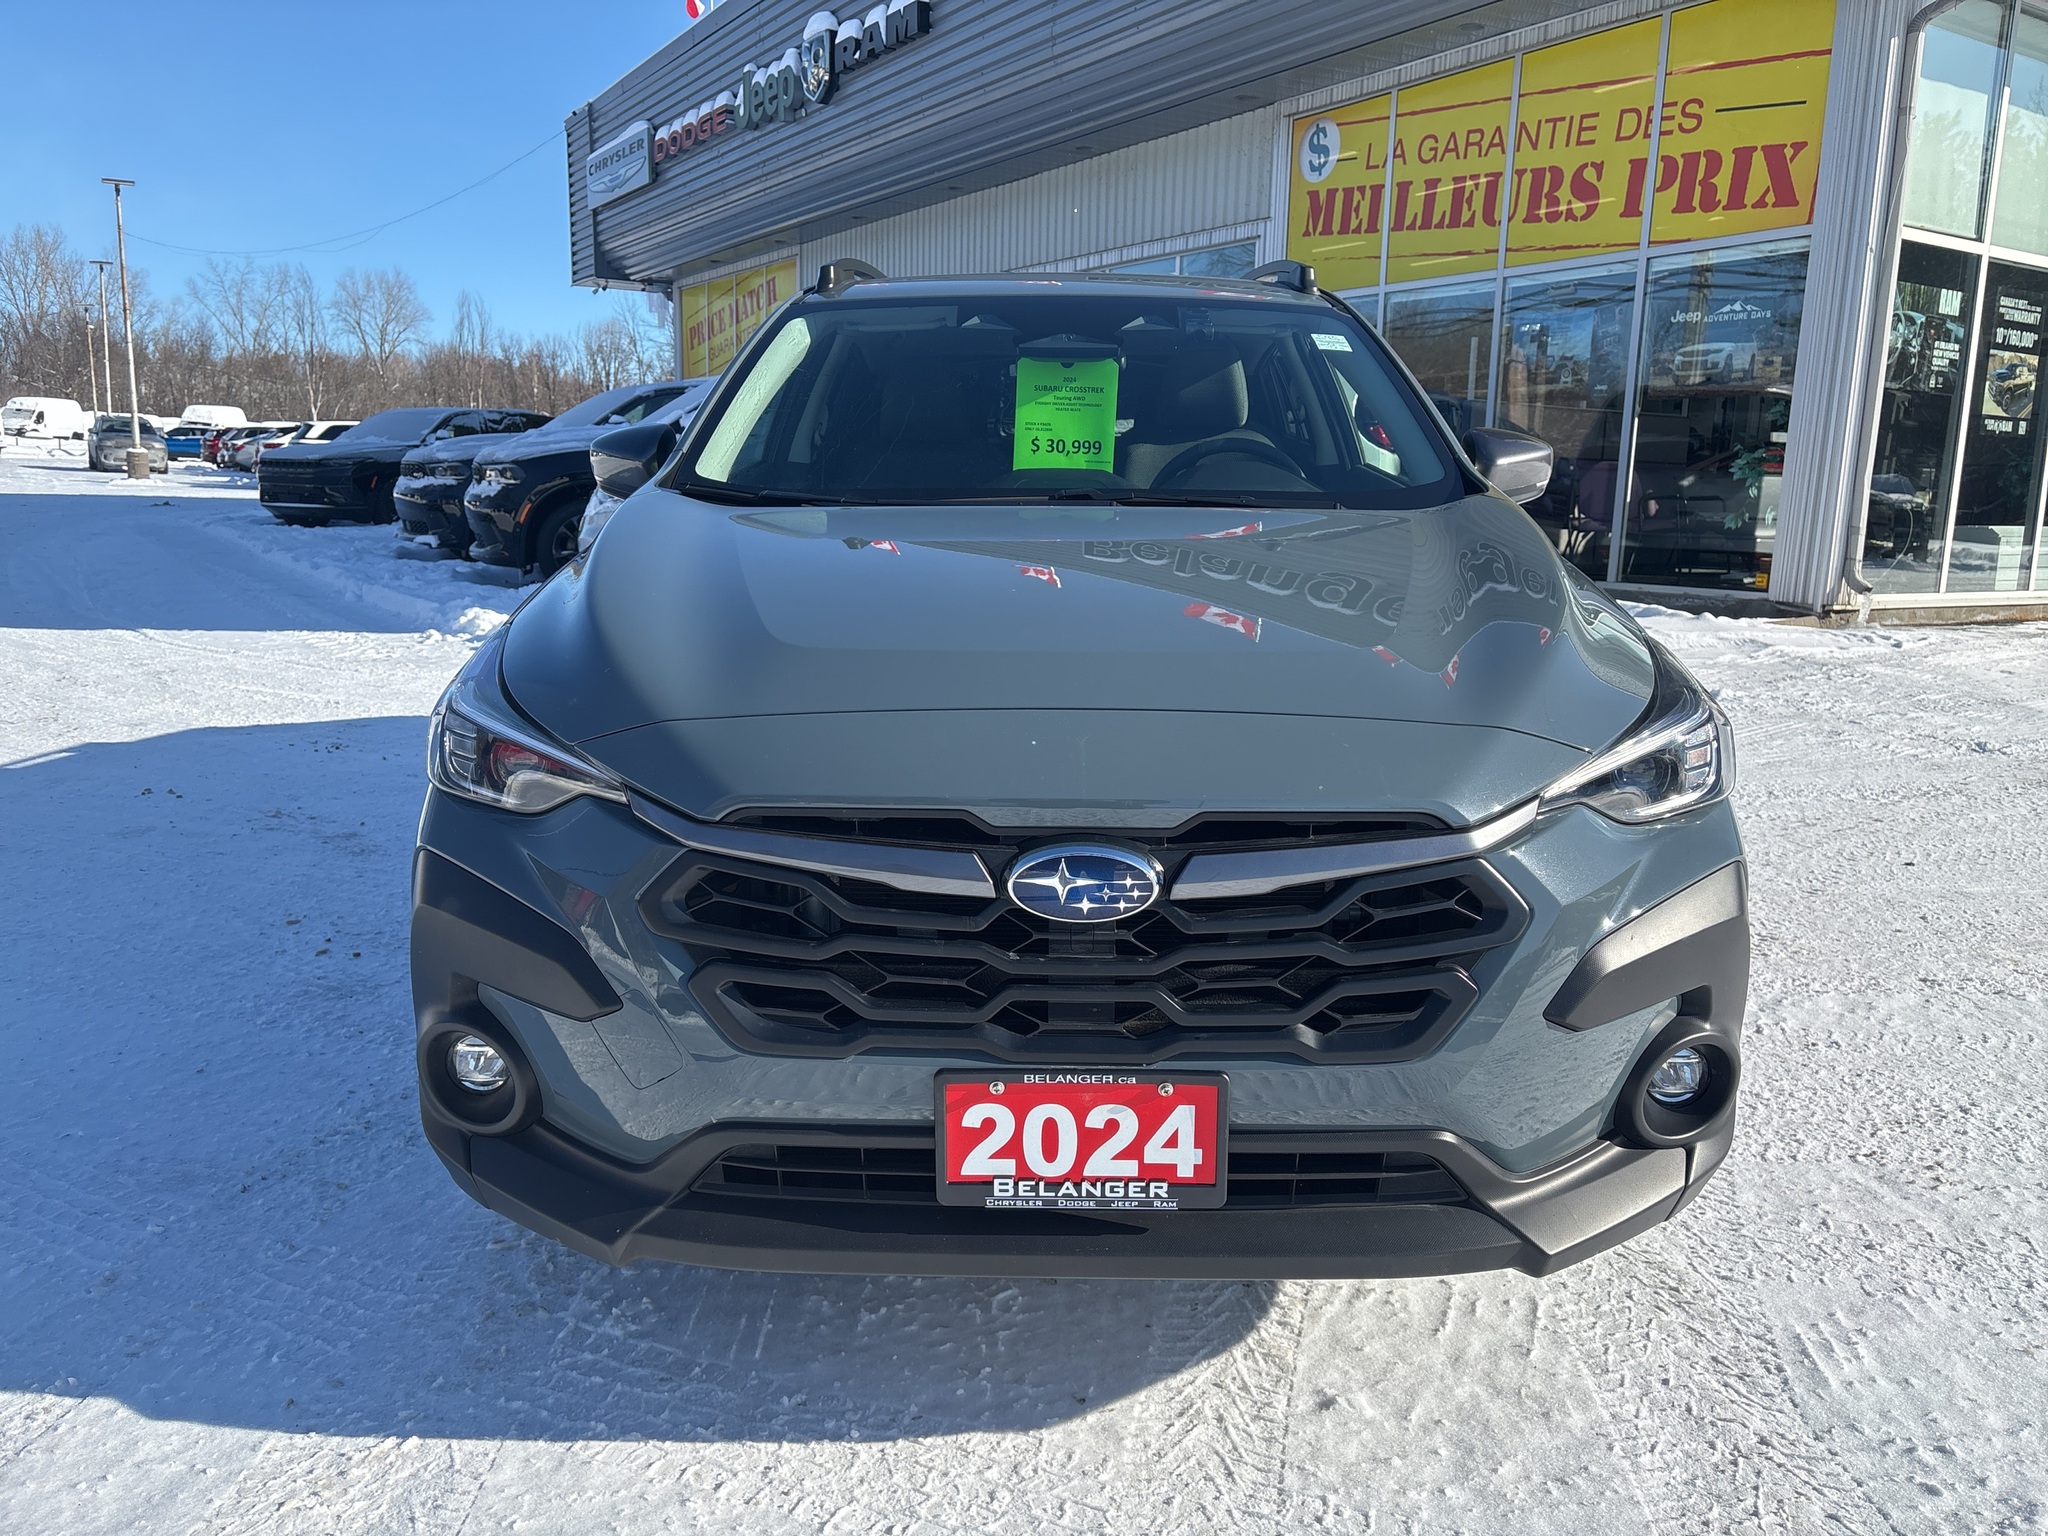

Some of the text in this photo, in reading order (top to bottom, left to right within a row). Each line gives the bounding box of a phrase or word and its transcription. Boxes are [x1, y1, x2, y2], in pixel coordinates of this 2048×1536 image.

[835, 1, 918, 73] RAM
[735, 65, 798, 129] Jeep
[589, 138, 645, 177] CHRYSLER
[653, 105, 728, 163] DODGE
[1365, 98, 1704, 170] LA GARANTIE DES
[1302, 141, 1809, 238] MEILLEURS PRIX
[688, 276, 778, 351] PRICE MATCH
[1670, 309, 1772, 323] Jeep ADVENTURE DAYS
[1939, 288, 1963, 317] RAM
[1033, 384, 1105, 394] SUBARU CROSSTREK
[1030, 436, 1103, 457] $ 30,999
[1023, 1074, 1137, 1085] BELANGER.ca
[960, 1102, 1204, 1178] 2024
[993, 1178, 1169, 1198] BELANGER
